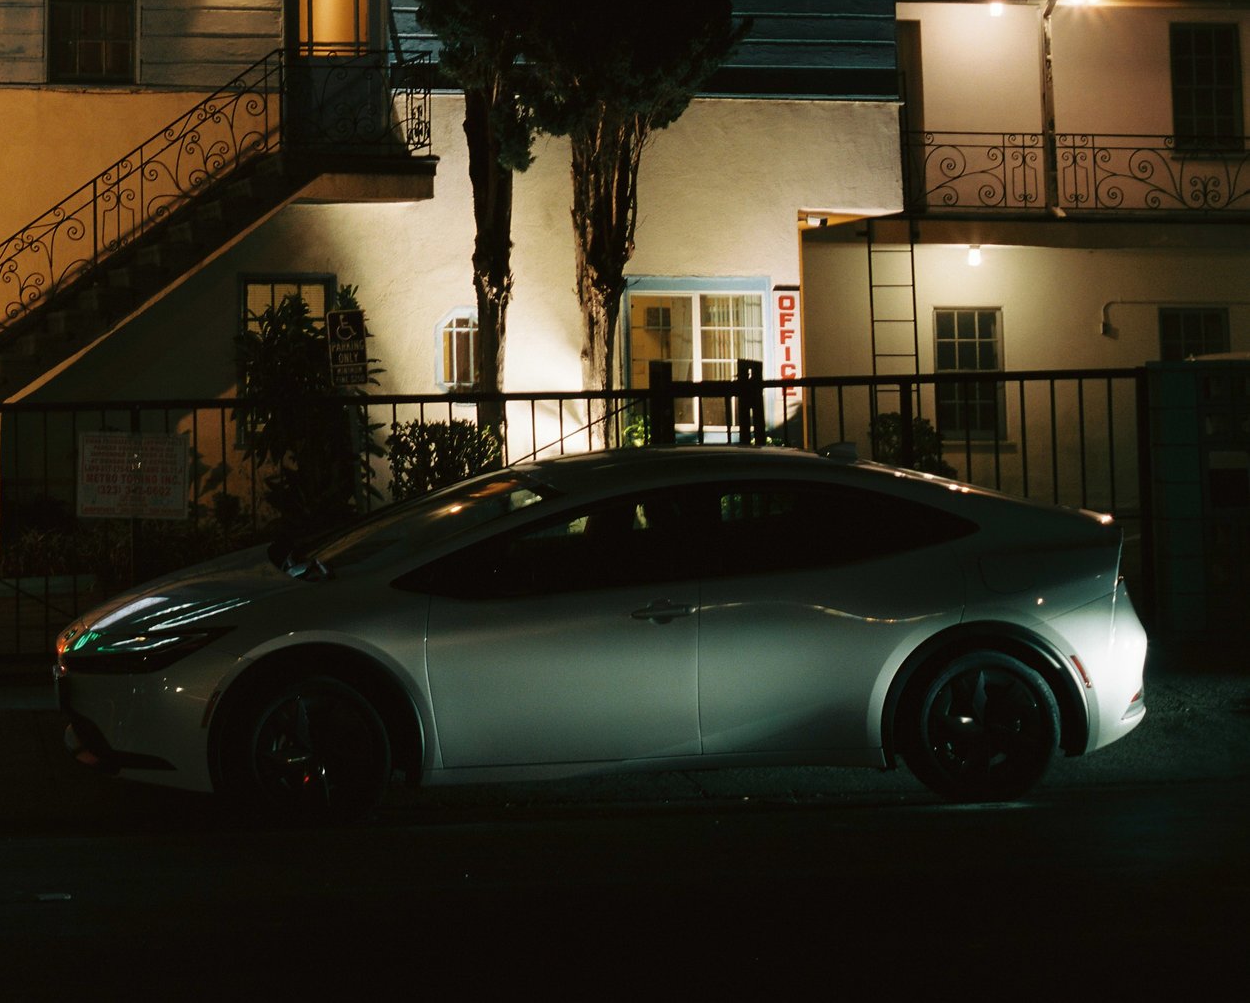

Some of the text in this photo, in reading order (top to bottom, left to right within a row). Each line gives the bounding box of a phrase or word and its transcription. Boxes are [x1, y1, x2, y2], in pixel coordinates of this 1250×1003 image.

[331, 339, 365, 352] PARKING
[338, 351, 359, 364] ONLY
[86, 473, 118, 484] METRO
